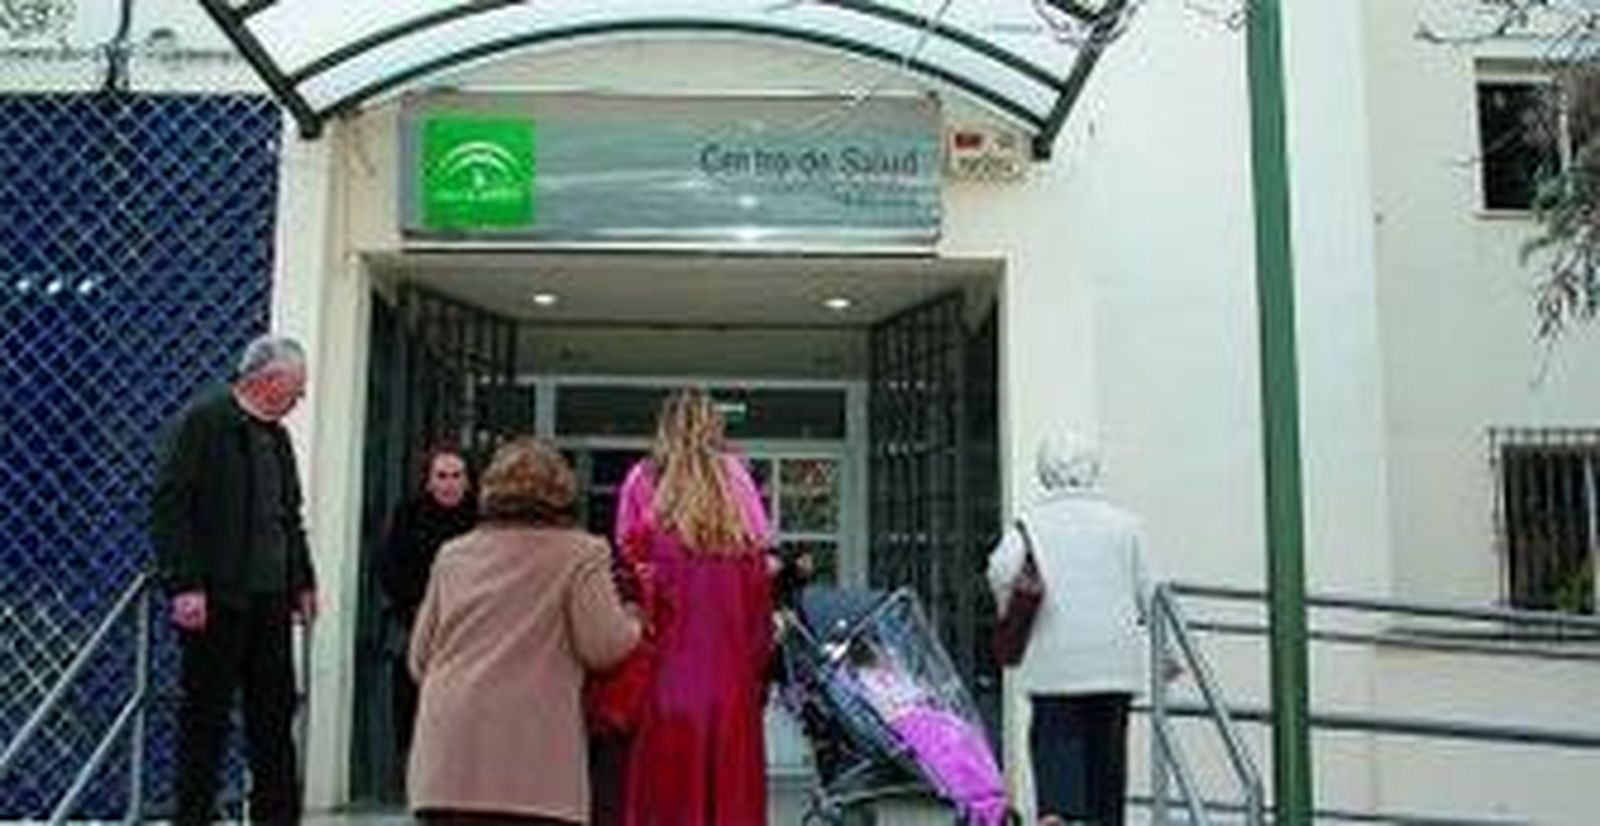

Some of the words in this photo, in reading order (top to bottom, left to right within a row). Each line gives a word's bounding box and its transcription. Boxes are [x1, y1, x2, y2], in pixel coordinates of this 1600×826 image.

[699, 144, 790, 175] Centro
[800, 147, 834, 175] de
[839, 146, 919, 175] Salud
